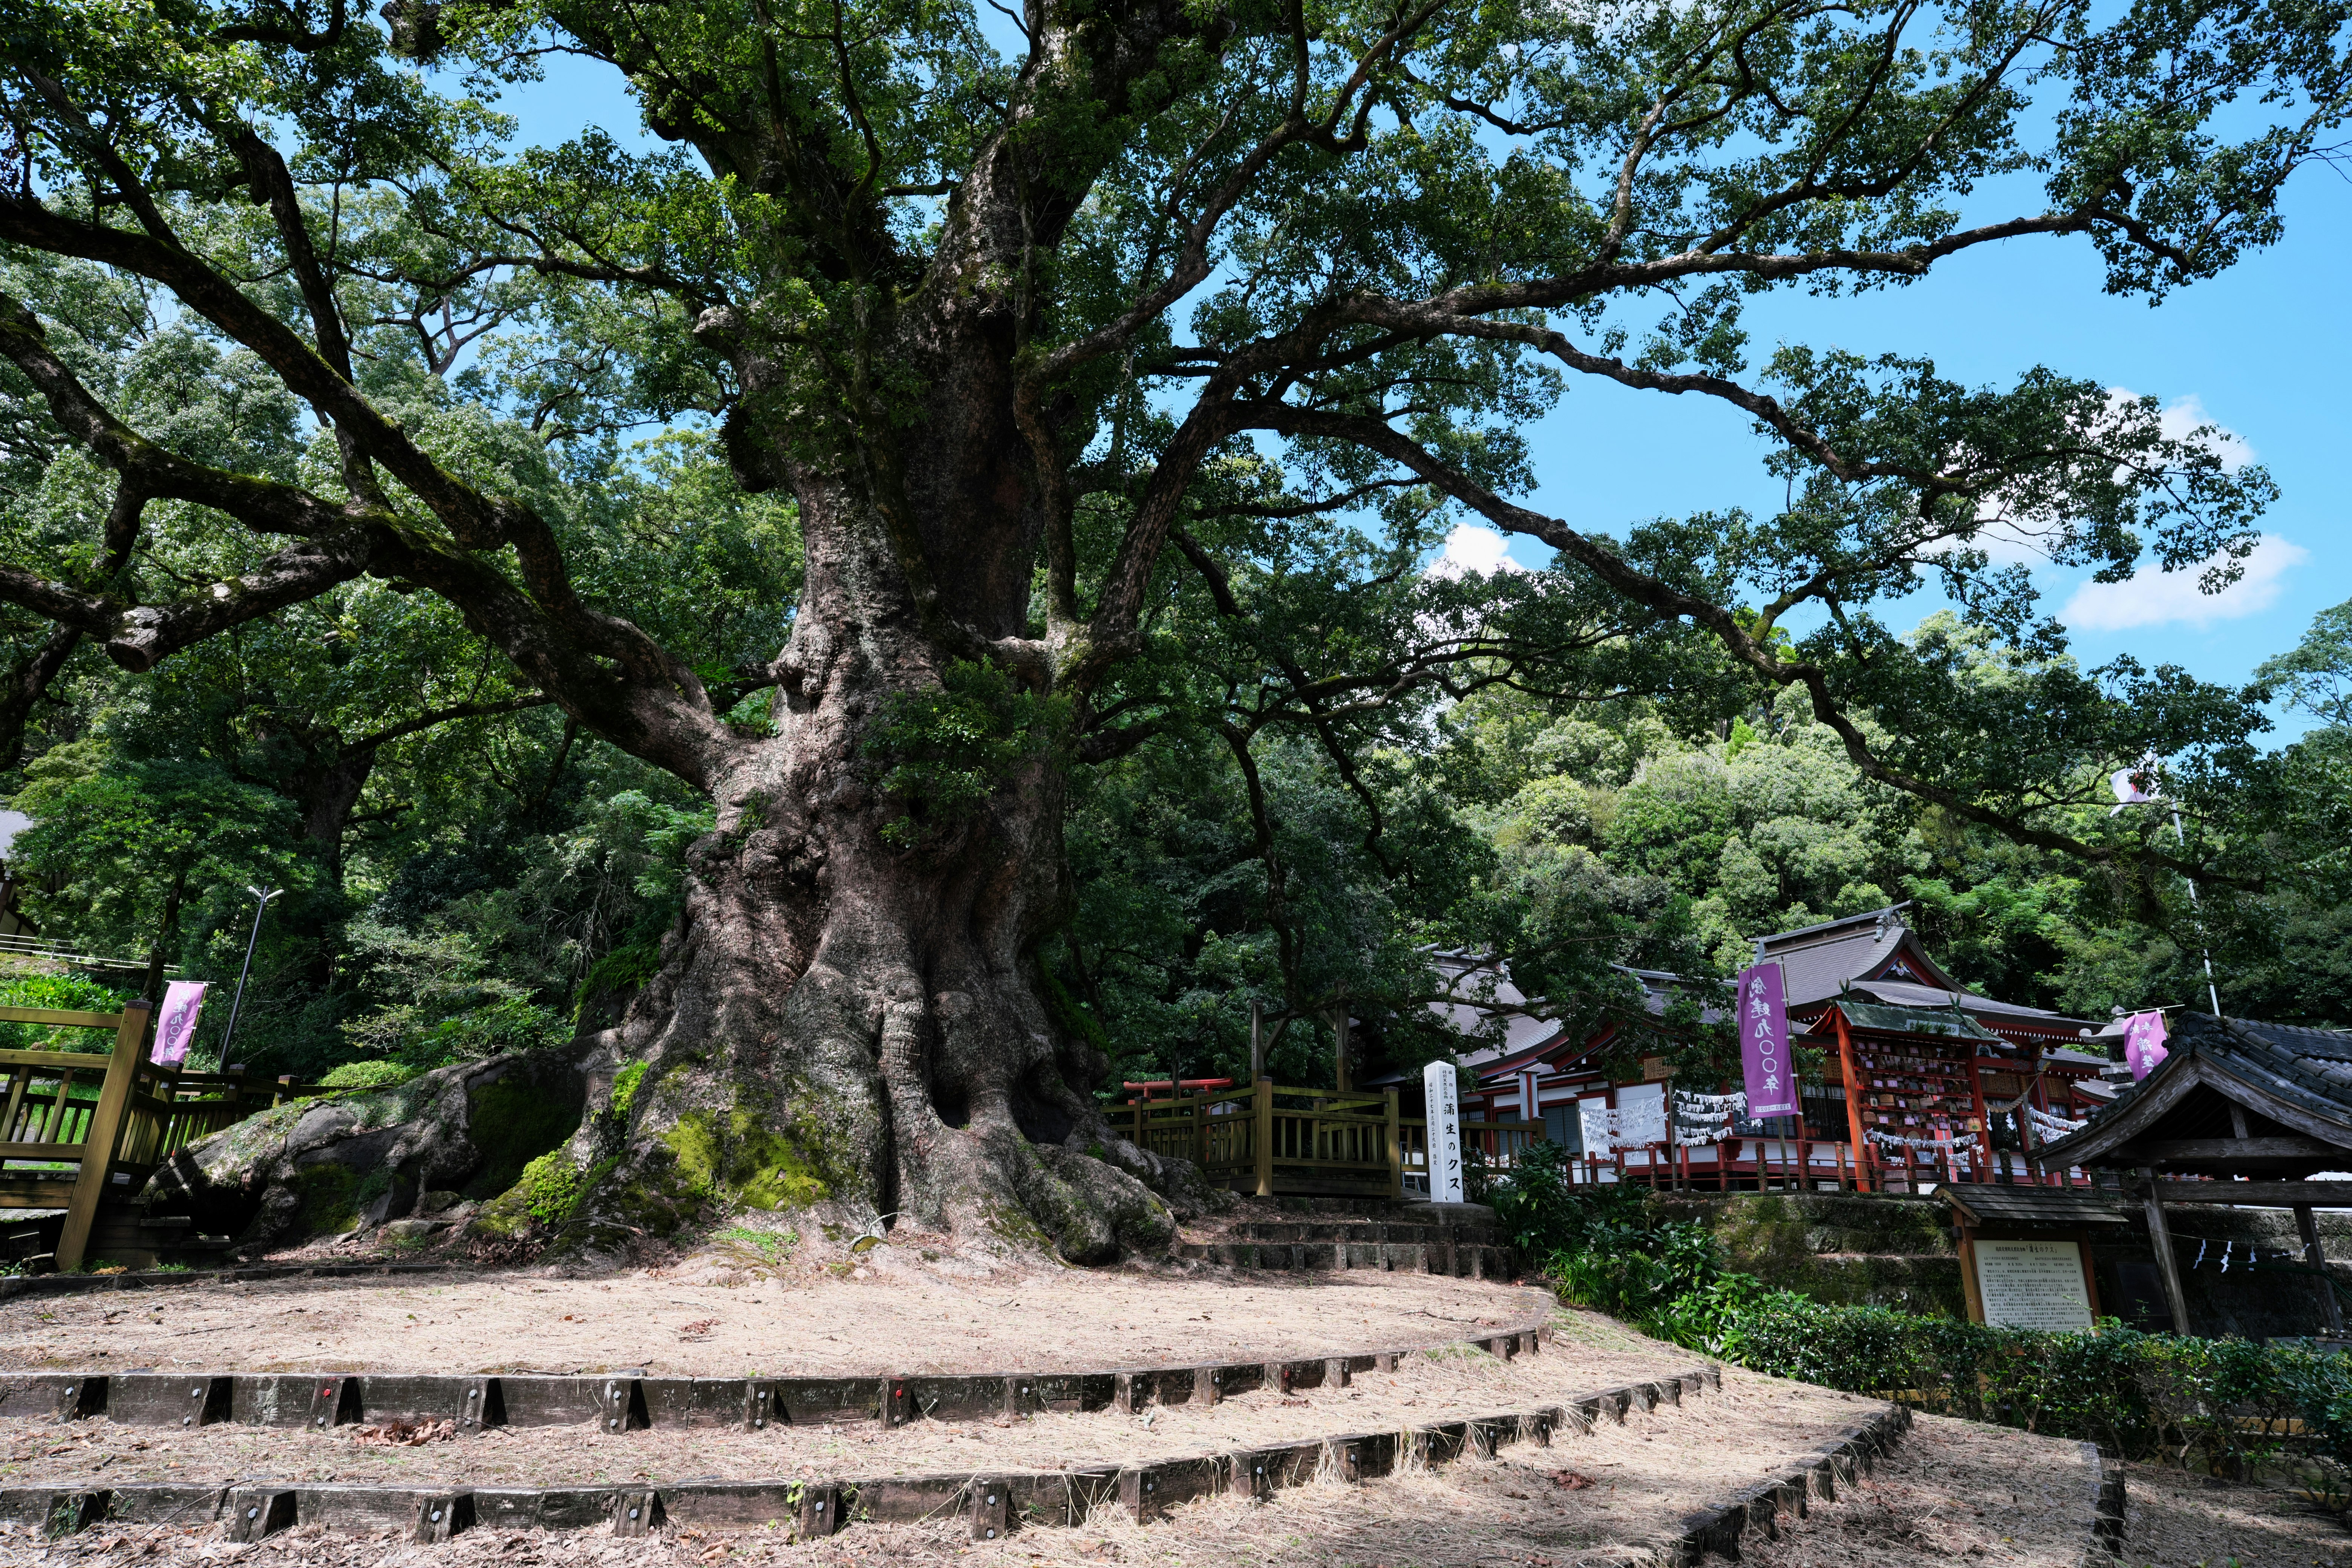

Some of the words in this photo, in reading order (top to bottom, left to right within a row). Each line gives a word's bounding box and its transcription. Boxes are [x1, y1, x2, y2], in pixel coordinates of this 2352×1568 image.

[1443, 1103, 1460, 1190] 蒲生のクス
